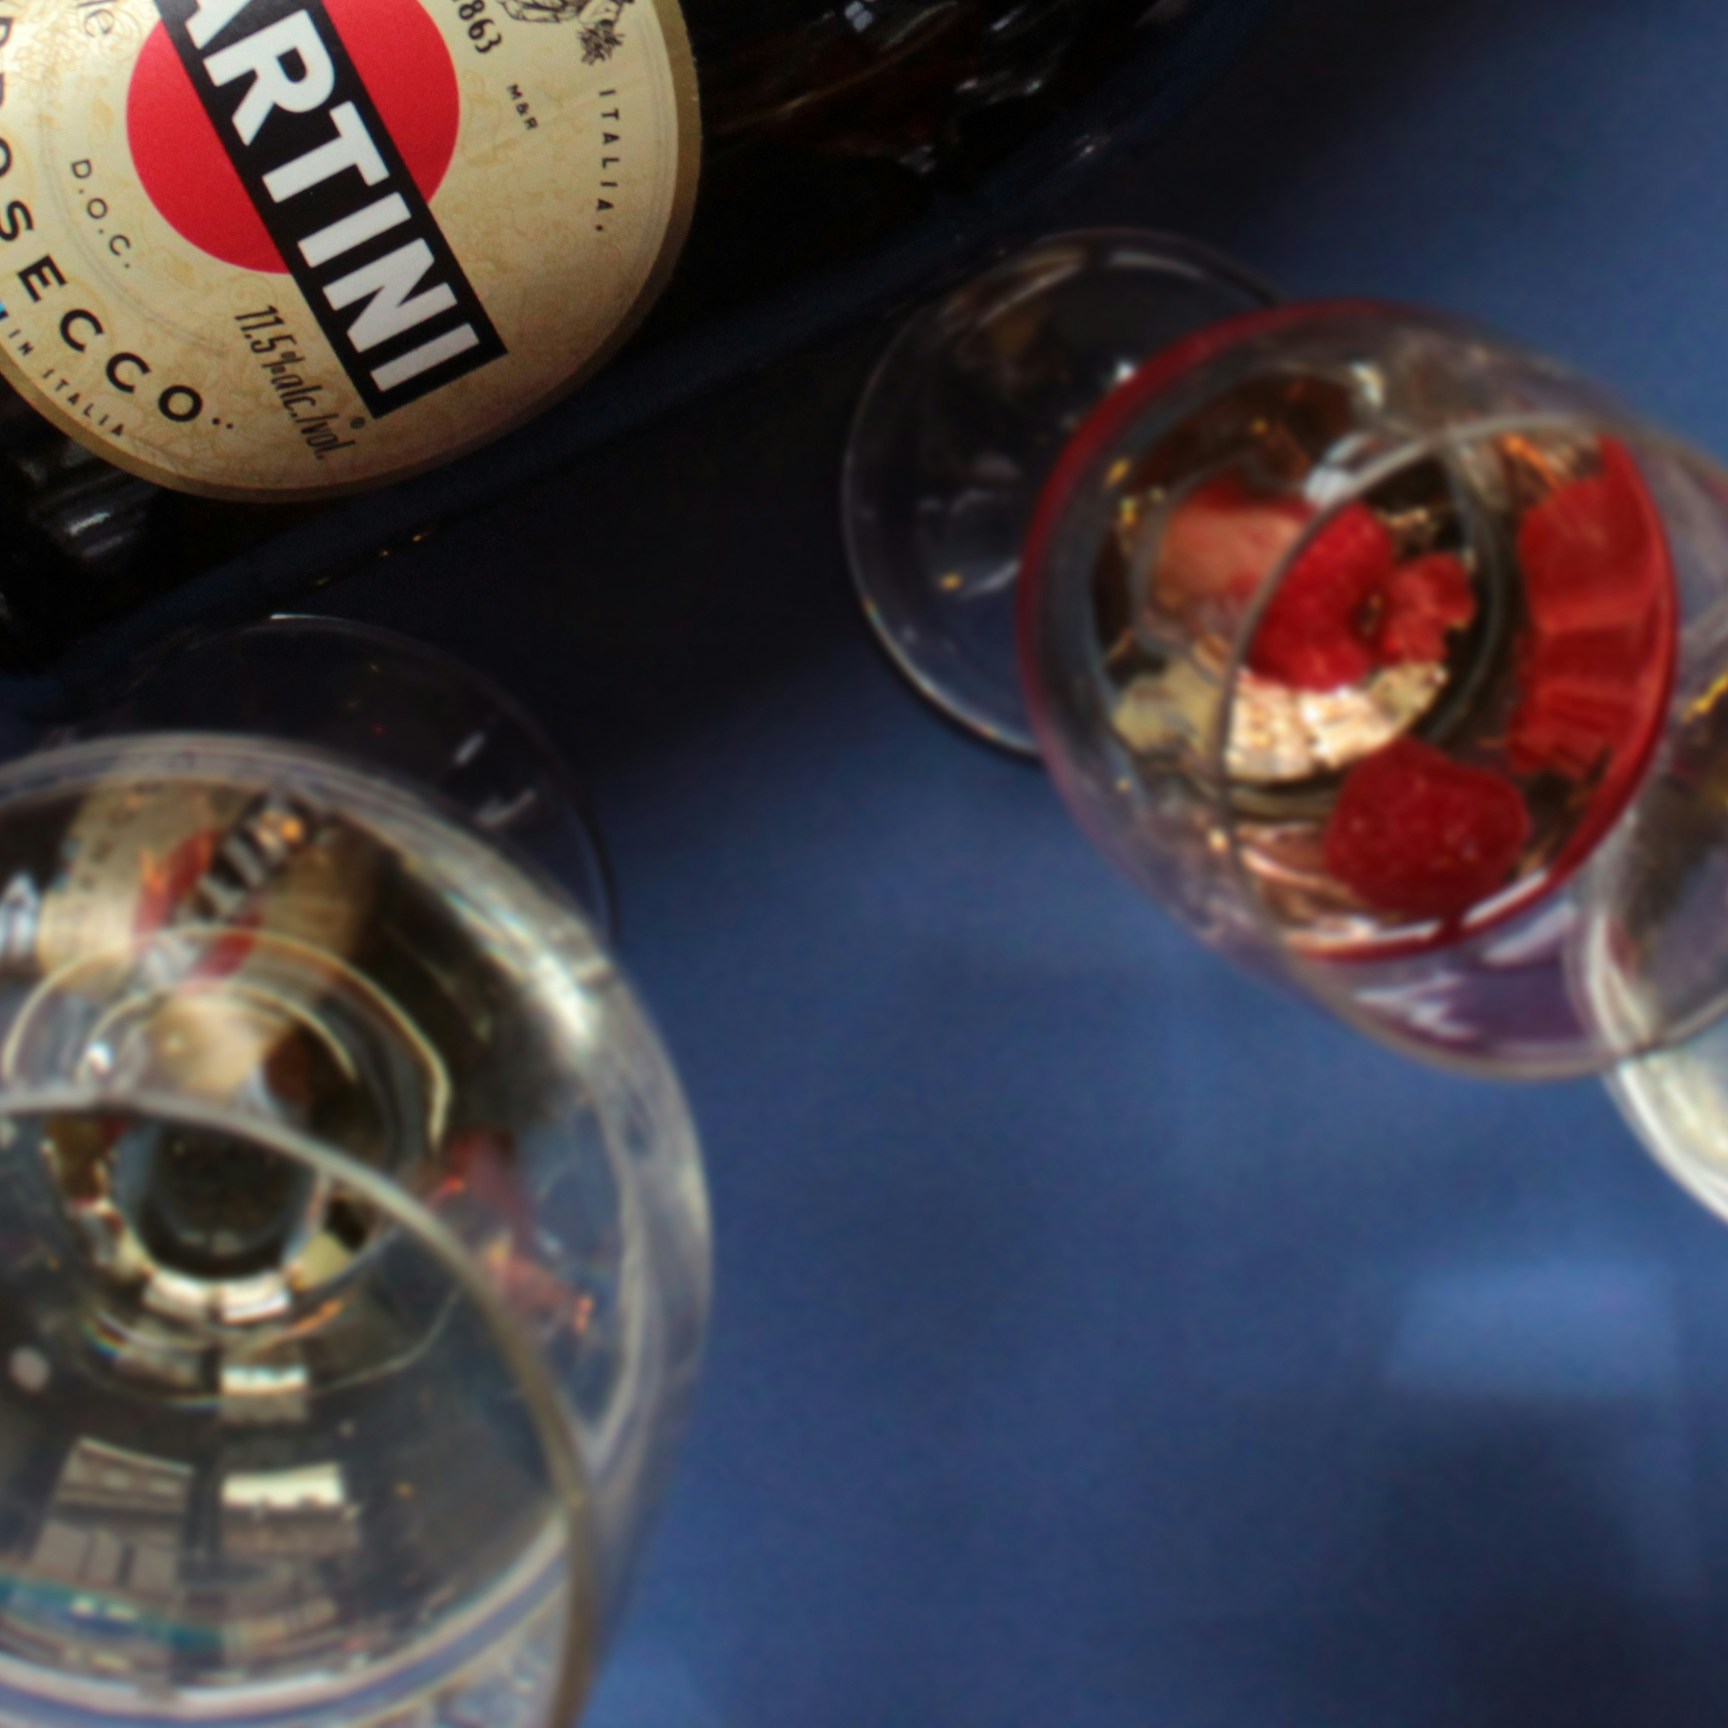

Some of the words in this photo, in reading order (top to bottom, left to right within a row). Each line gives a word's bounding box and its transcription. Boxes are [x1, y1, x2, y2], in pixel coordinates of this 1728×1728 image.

[506, 83, 539, 132] M&R
[71, 158, 132, 269] D.O.C.
[8, 328, 33, 357] IN
[42, 368, 126, 438] ITALIA
